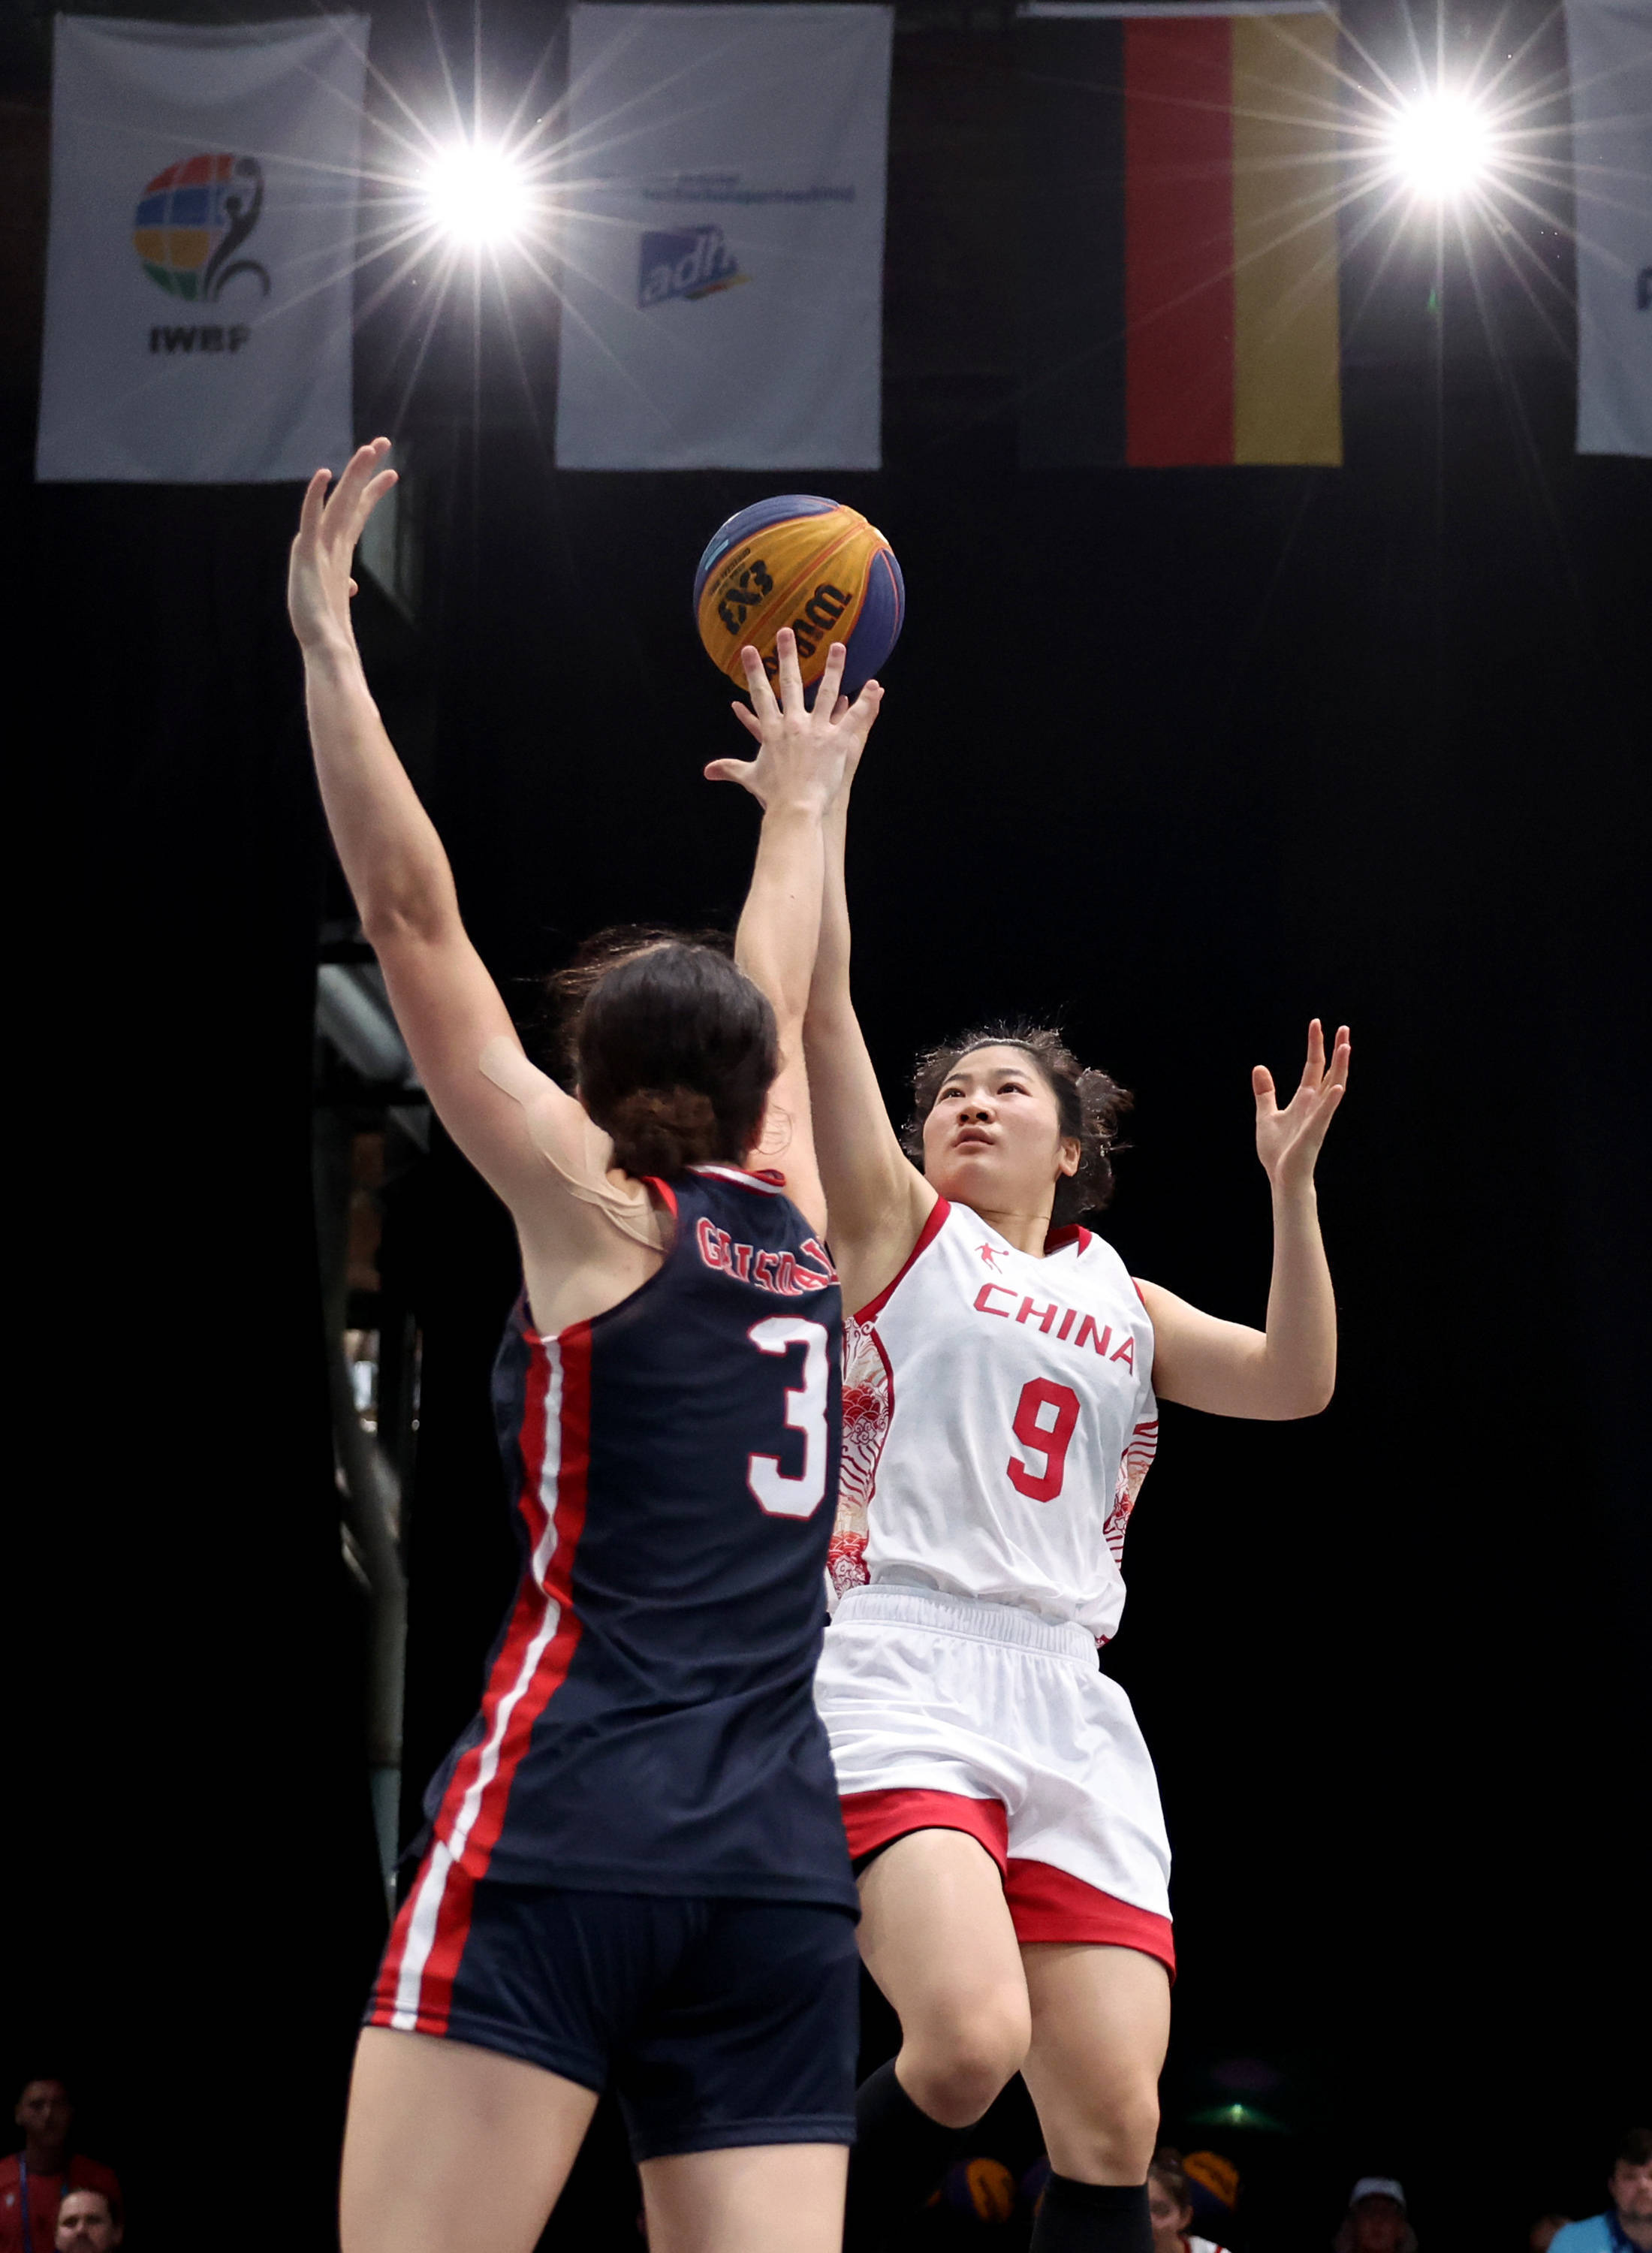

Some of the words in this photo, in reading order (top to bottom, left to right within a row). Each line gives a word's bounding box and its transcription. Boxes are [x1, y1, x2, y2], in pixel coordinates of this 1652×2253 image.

[973, 1282, 1135, 1375] CHINA
[746, 1313, 831, 1521] 3
[1006, 1377, 1081, 1503] 9
